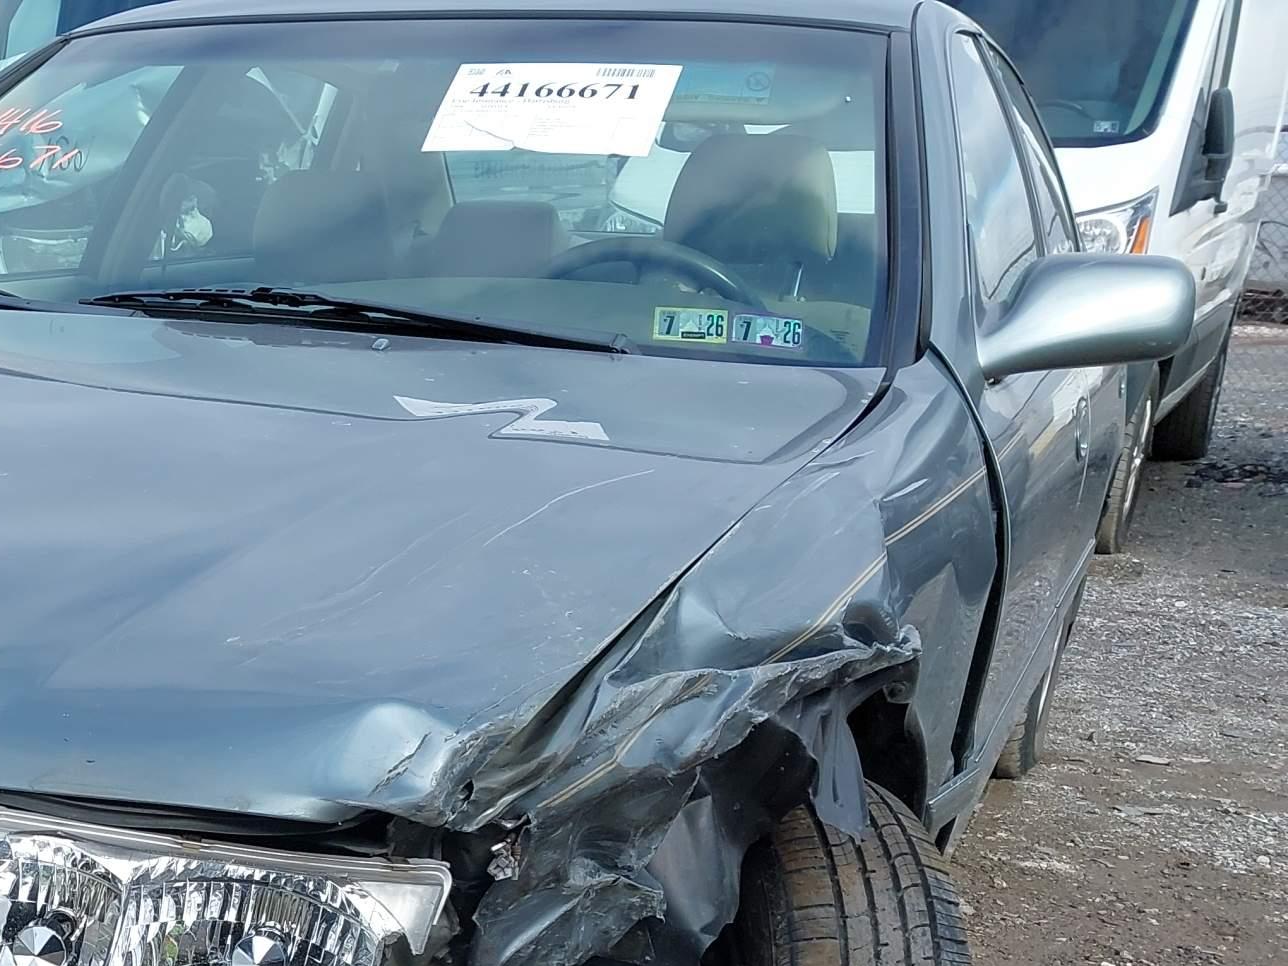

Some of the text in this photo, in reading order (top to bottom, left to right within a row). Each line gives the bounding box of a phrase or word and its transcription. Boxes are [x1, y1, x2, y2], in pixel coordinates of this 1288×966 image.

[469, 81, 640, 100] 44166671
[664, 315, 675, 335] 7
[706, 314, 724, 337] 26
[741, 320, 752, 341] 7
[783, 321, 801, 345] 26
